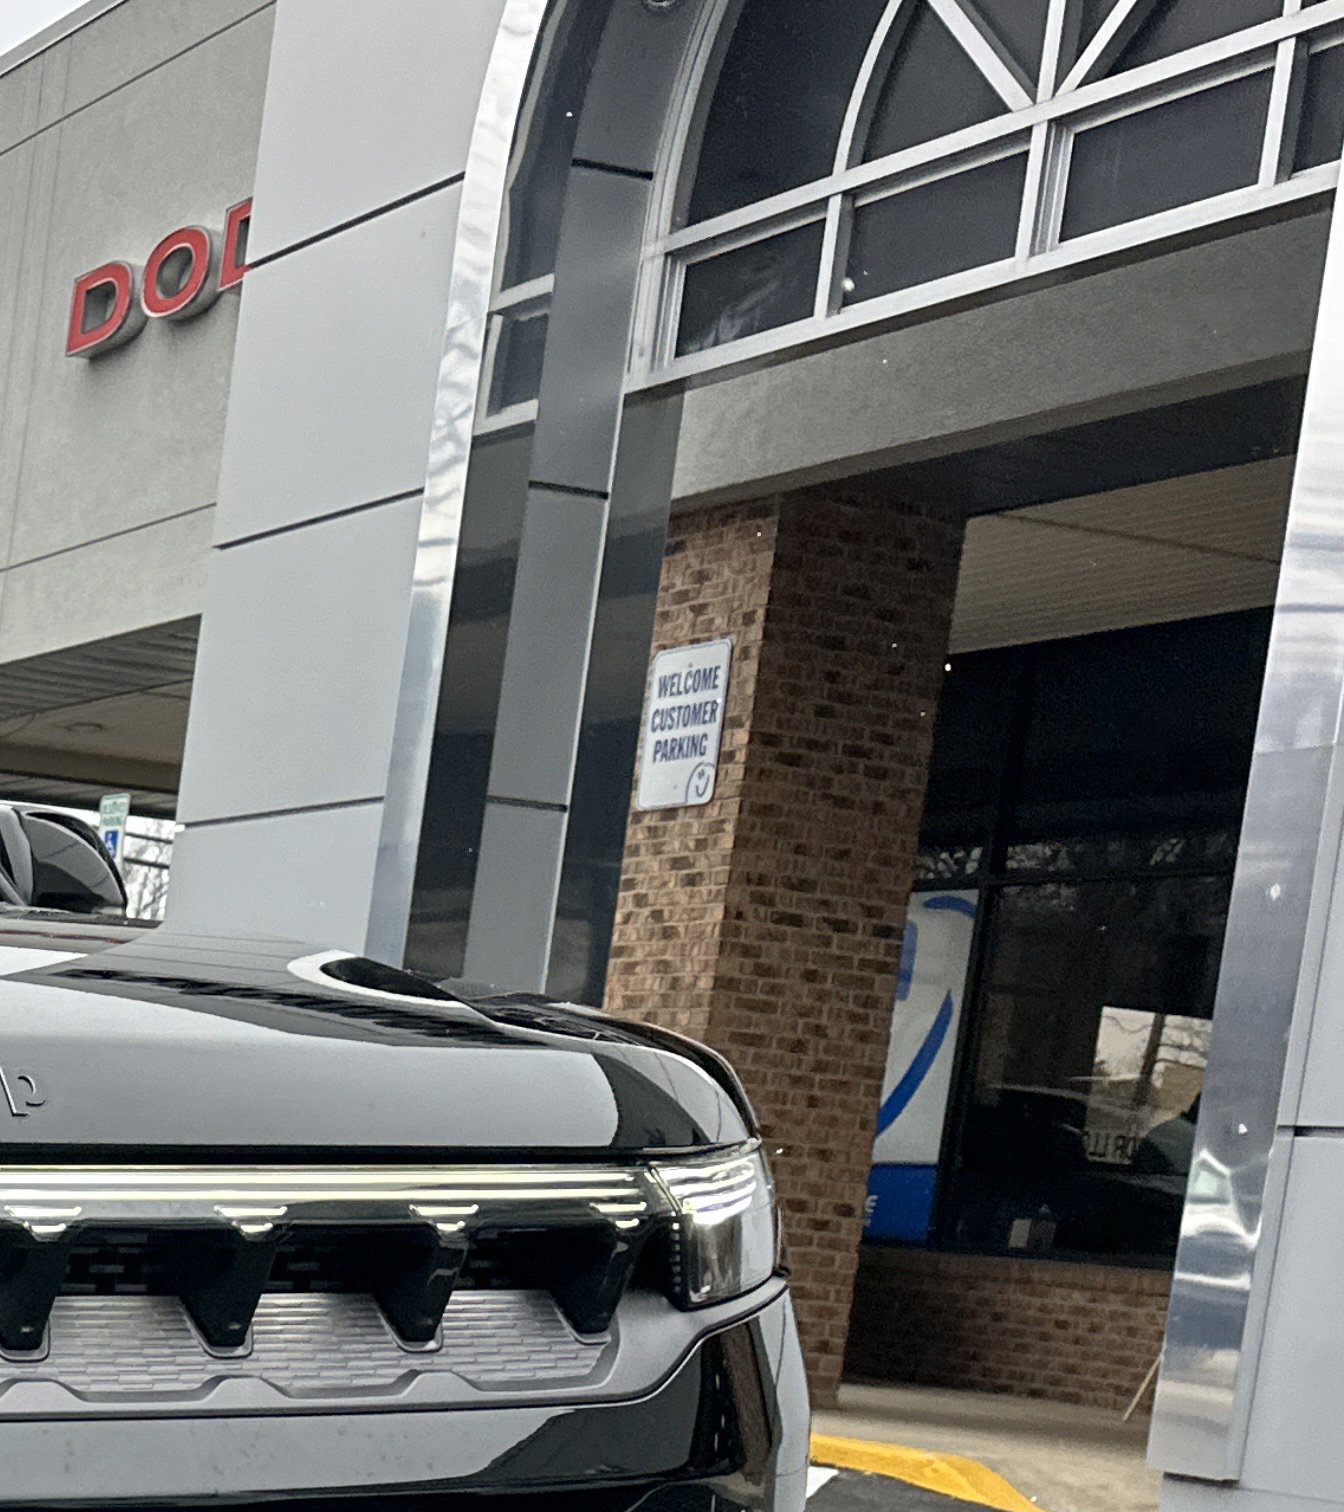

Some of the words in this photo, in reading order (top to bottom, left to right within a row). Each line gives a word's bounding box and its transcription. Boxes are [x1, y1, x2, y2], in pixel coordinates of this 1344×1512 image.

[657, 665, 721, 698] WELCOME
[650, 700, 719, 733] CUSTOMER
[652, 733, 708, 763] PARKING
